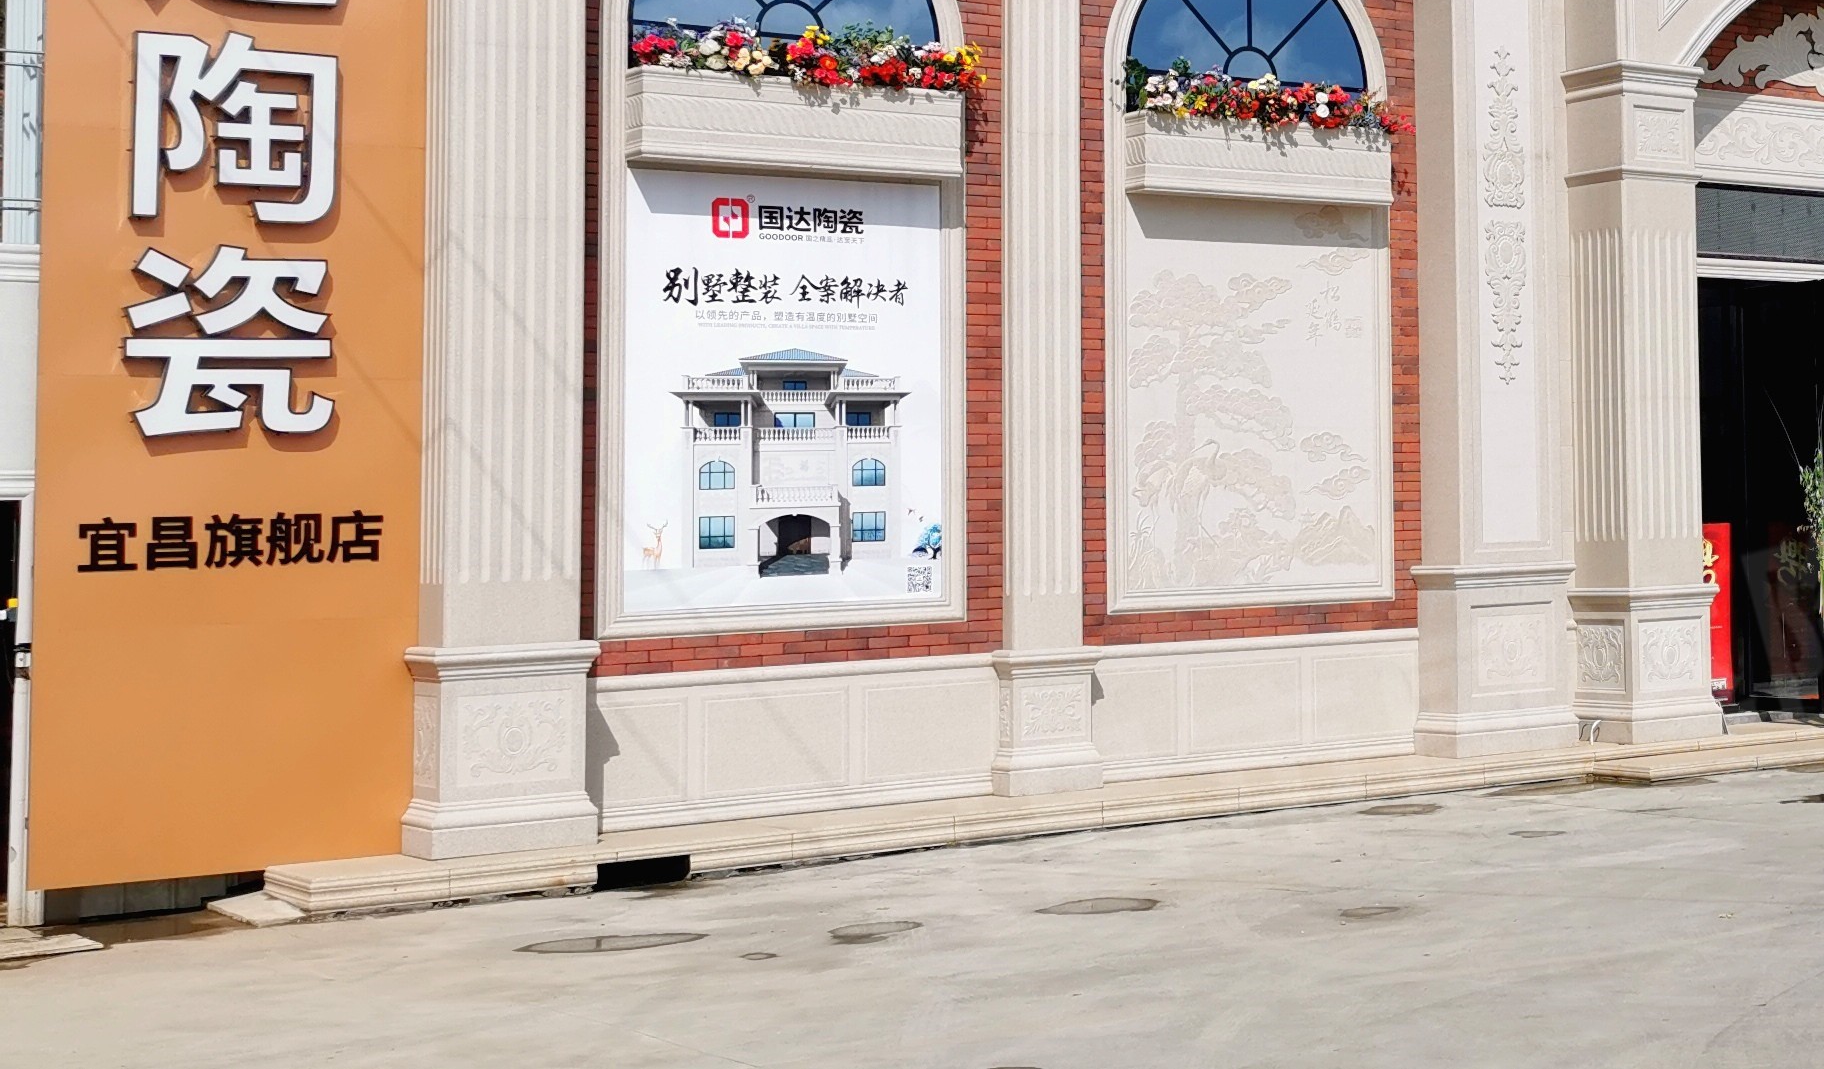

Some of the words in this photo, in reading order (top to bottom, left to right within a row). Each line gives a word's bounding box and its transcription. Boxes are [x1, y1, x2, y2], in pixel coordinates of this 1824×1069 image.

[758, 205, 864, 235] 国达陶瓷
[759, 233, 803, 241] GOODOOR
[77, 510, 384, 573] 宜昌旗舰店
